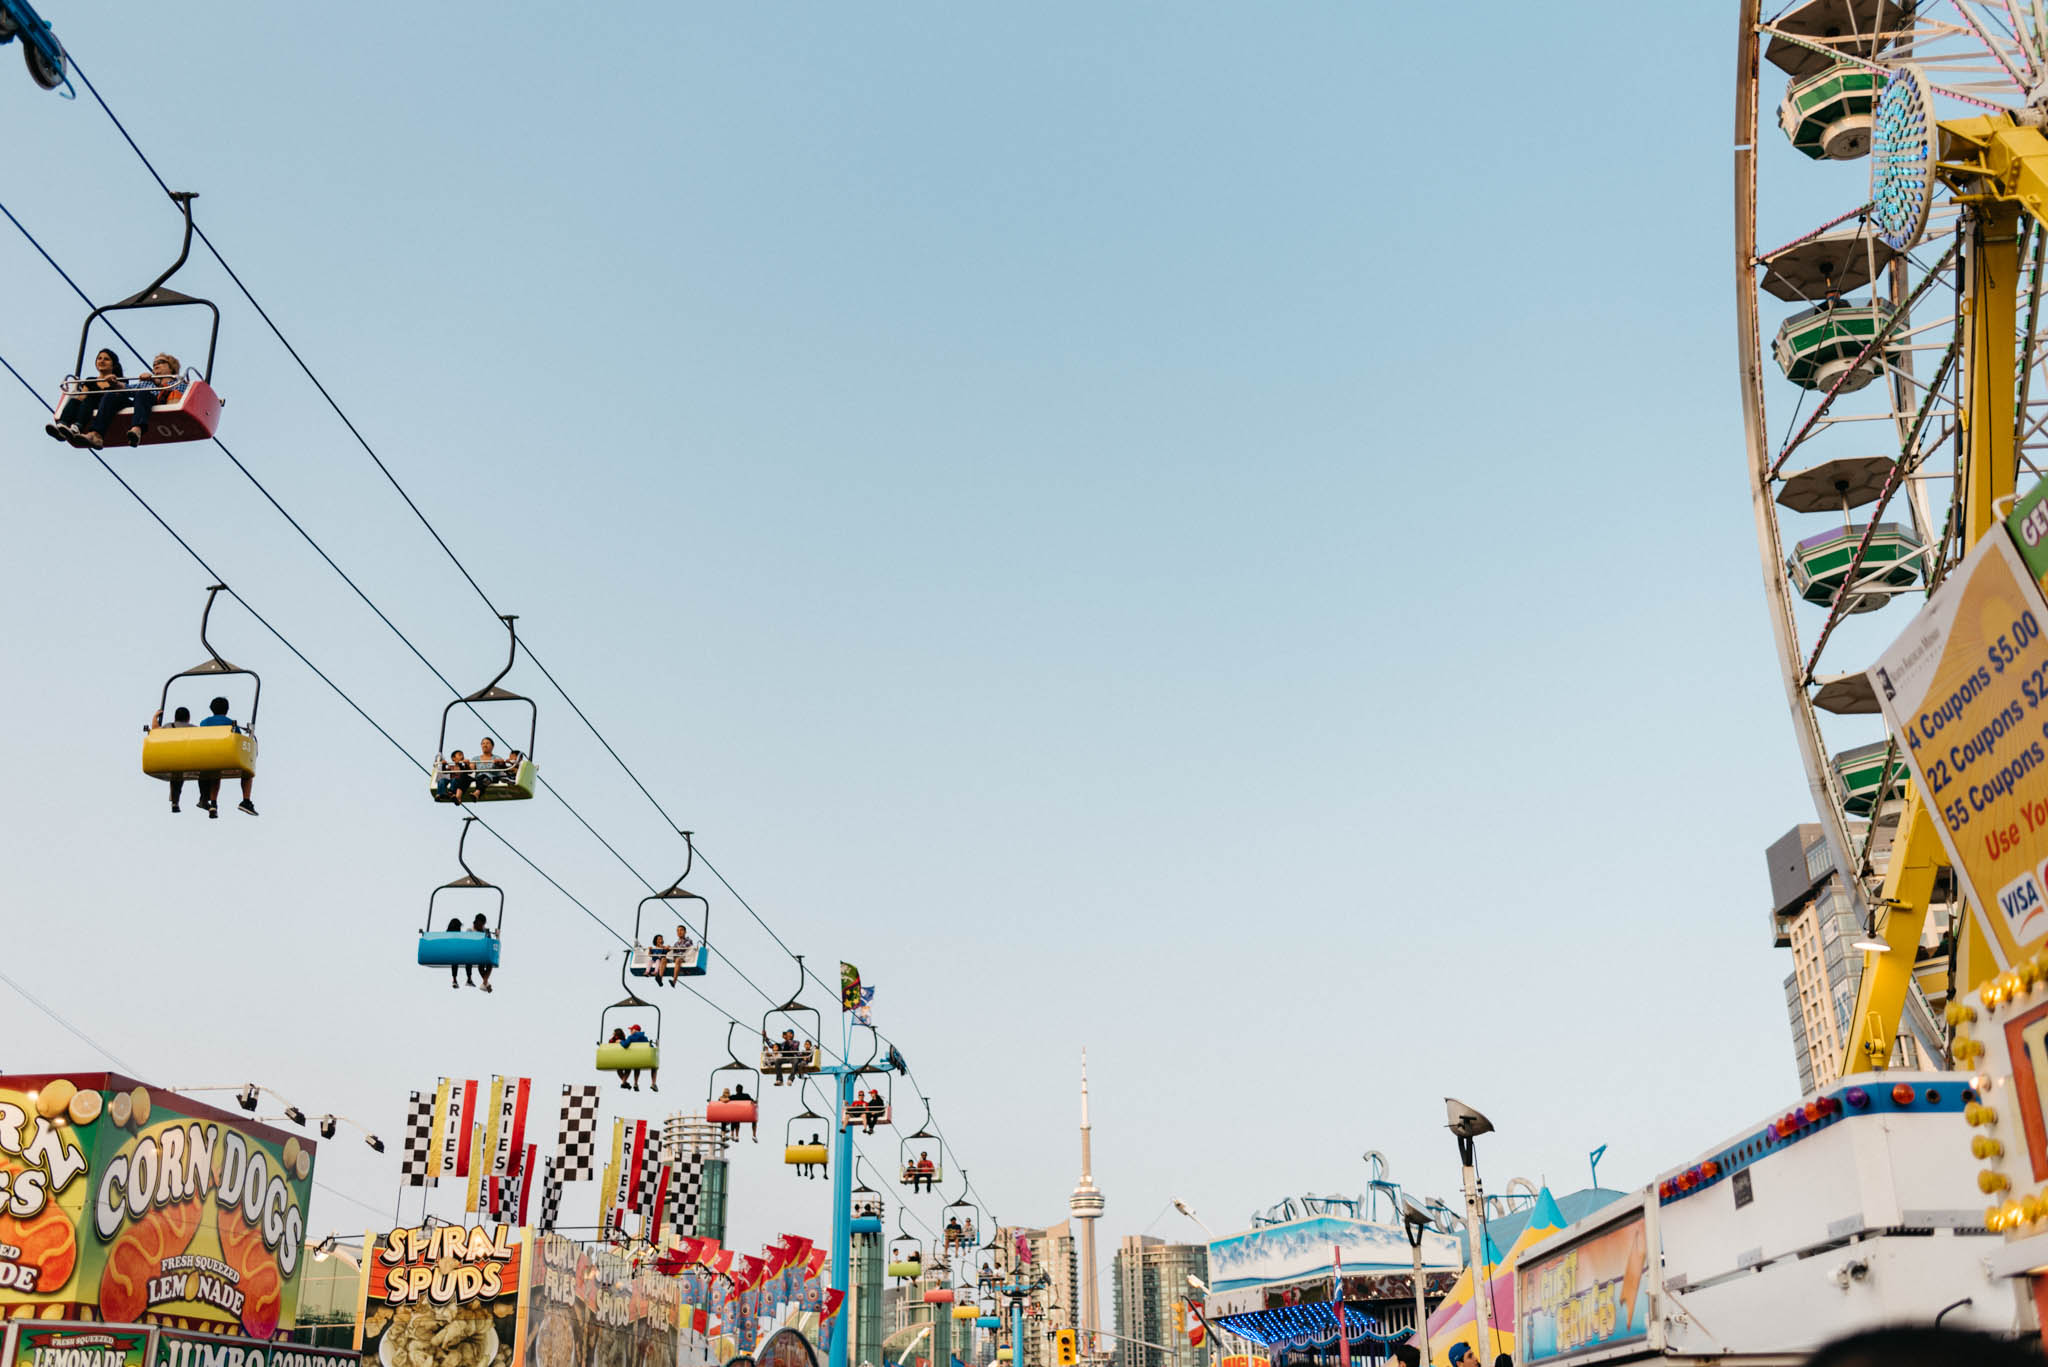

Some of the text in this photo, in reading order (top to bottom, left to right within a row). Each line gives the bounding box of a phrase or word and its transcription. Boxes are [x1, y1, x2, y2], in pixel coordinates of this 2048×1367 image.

[1909, 727, 1921, 750] 4
[1920, 665, 1991, 739] Coupons
[1988, 610, 2039, 673] $5.00
[1927, 760, 1952, 794] 22
[1950, 699, 2024, 773] Coupons
[1945, 741, 2044, 831] 55 Coupons
[1985, 823, 2020, 861] Use
[2002, 879, 2039, 919] VISA
[444, 1086, 462, 1170] FRIES
[494, 1085, 516, 1169] FRIES
[618, 1126, 633, 1203] FRIES
[96, 1123, 303, 1274] CORN DOGS
[381, 1225, 513, 1264] SPIRAL
[544, 1232, 580, 1272] CURLY
[162, 1255, 240, 1283] FRESH SQUEEZED
[386, 1262, 504, 1304] SPUDS
[545, 1268, 576, 1306] FRIES
[596, 1289, 630, 1327] SPUDS
